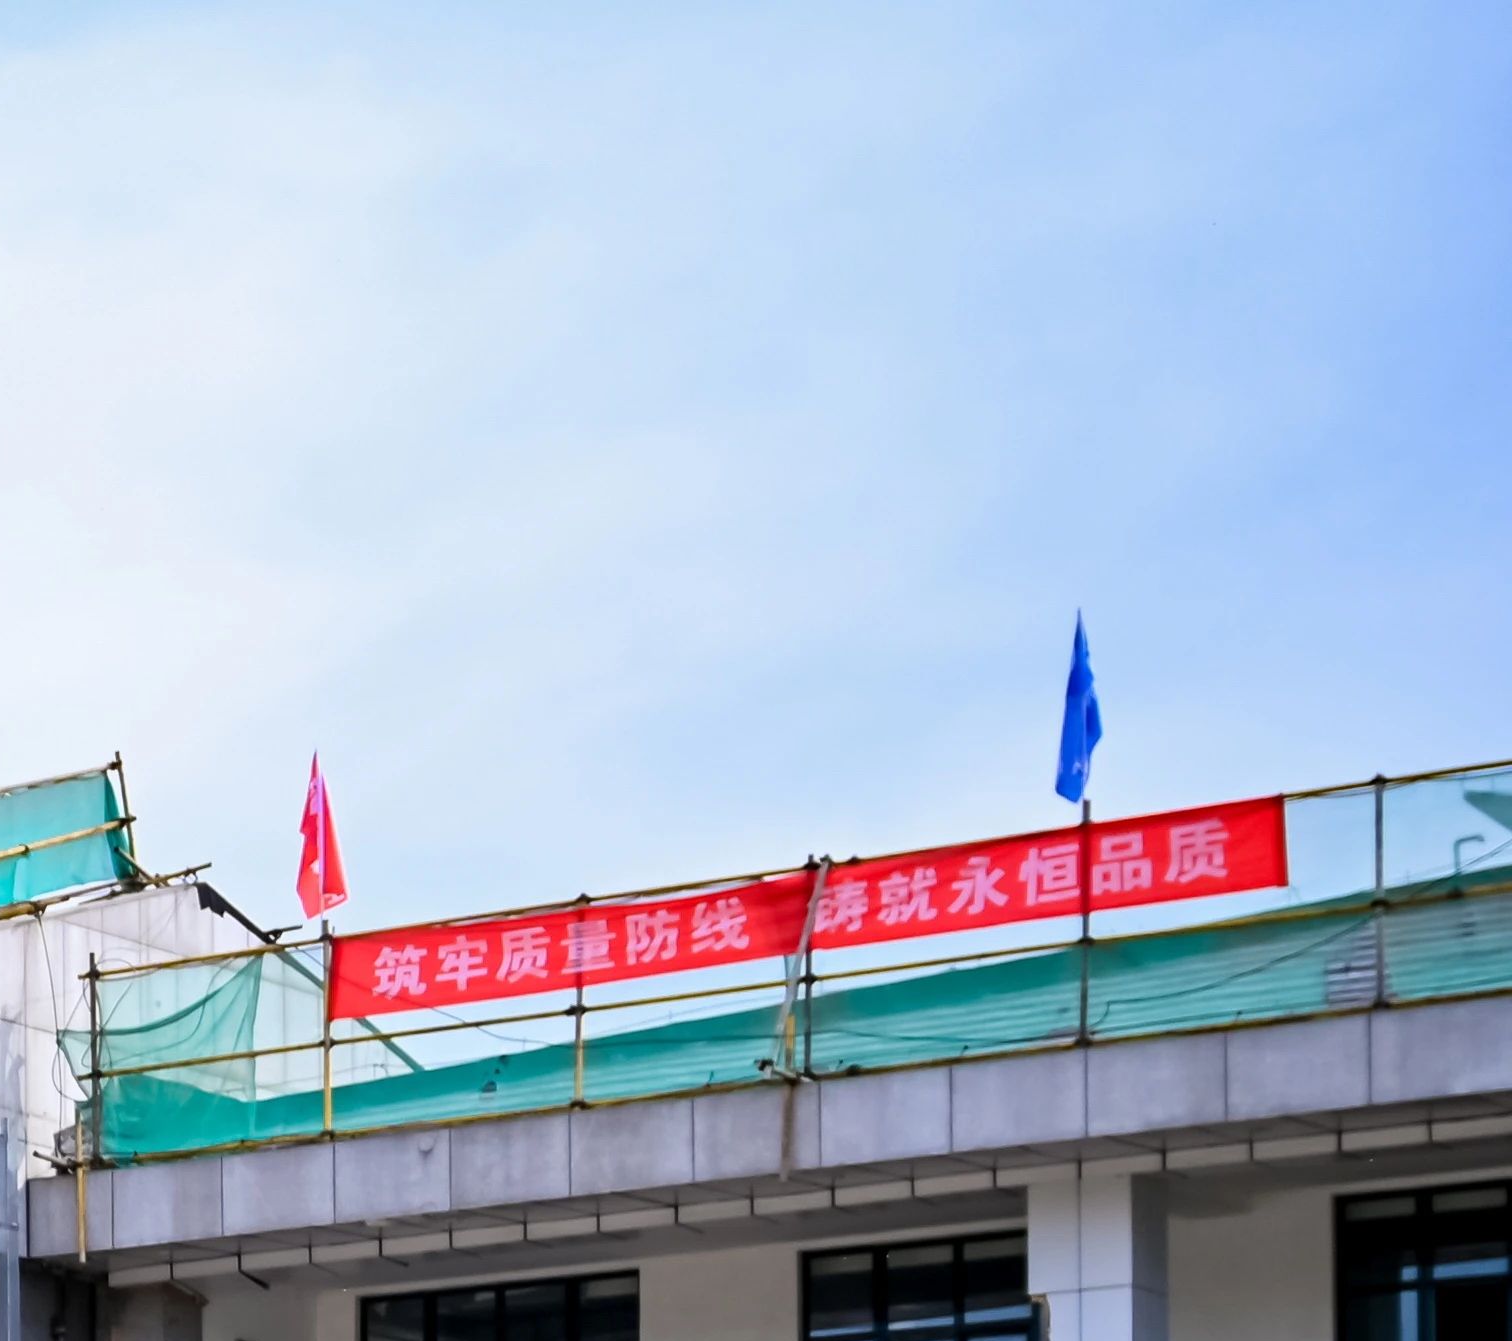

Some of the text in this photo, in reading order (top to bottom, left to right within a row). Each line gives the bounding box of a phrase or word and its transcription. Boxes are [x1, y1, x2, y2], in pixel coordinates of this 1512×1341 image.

[373, 818, 1231, 1000] 筑牢质量防线 铸就永恒品质
